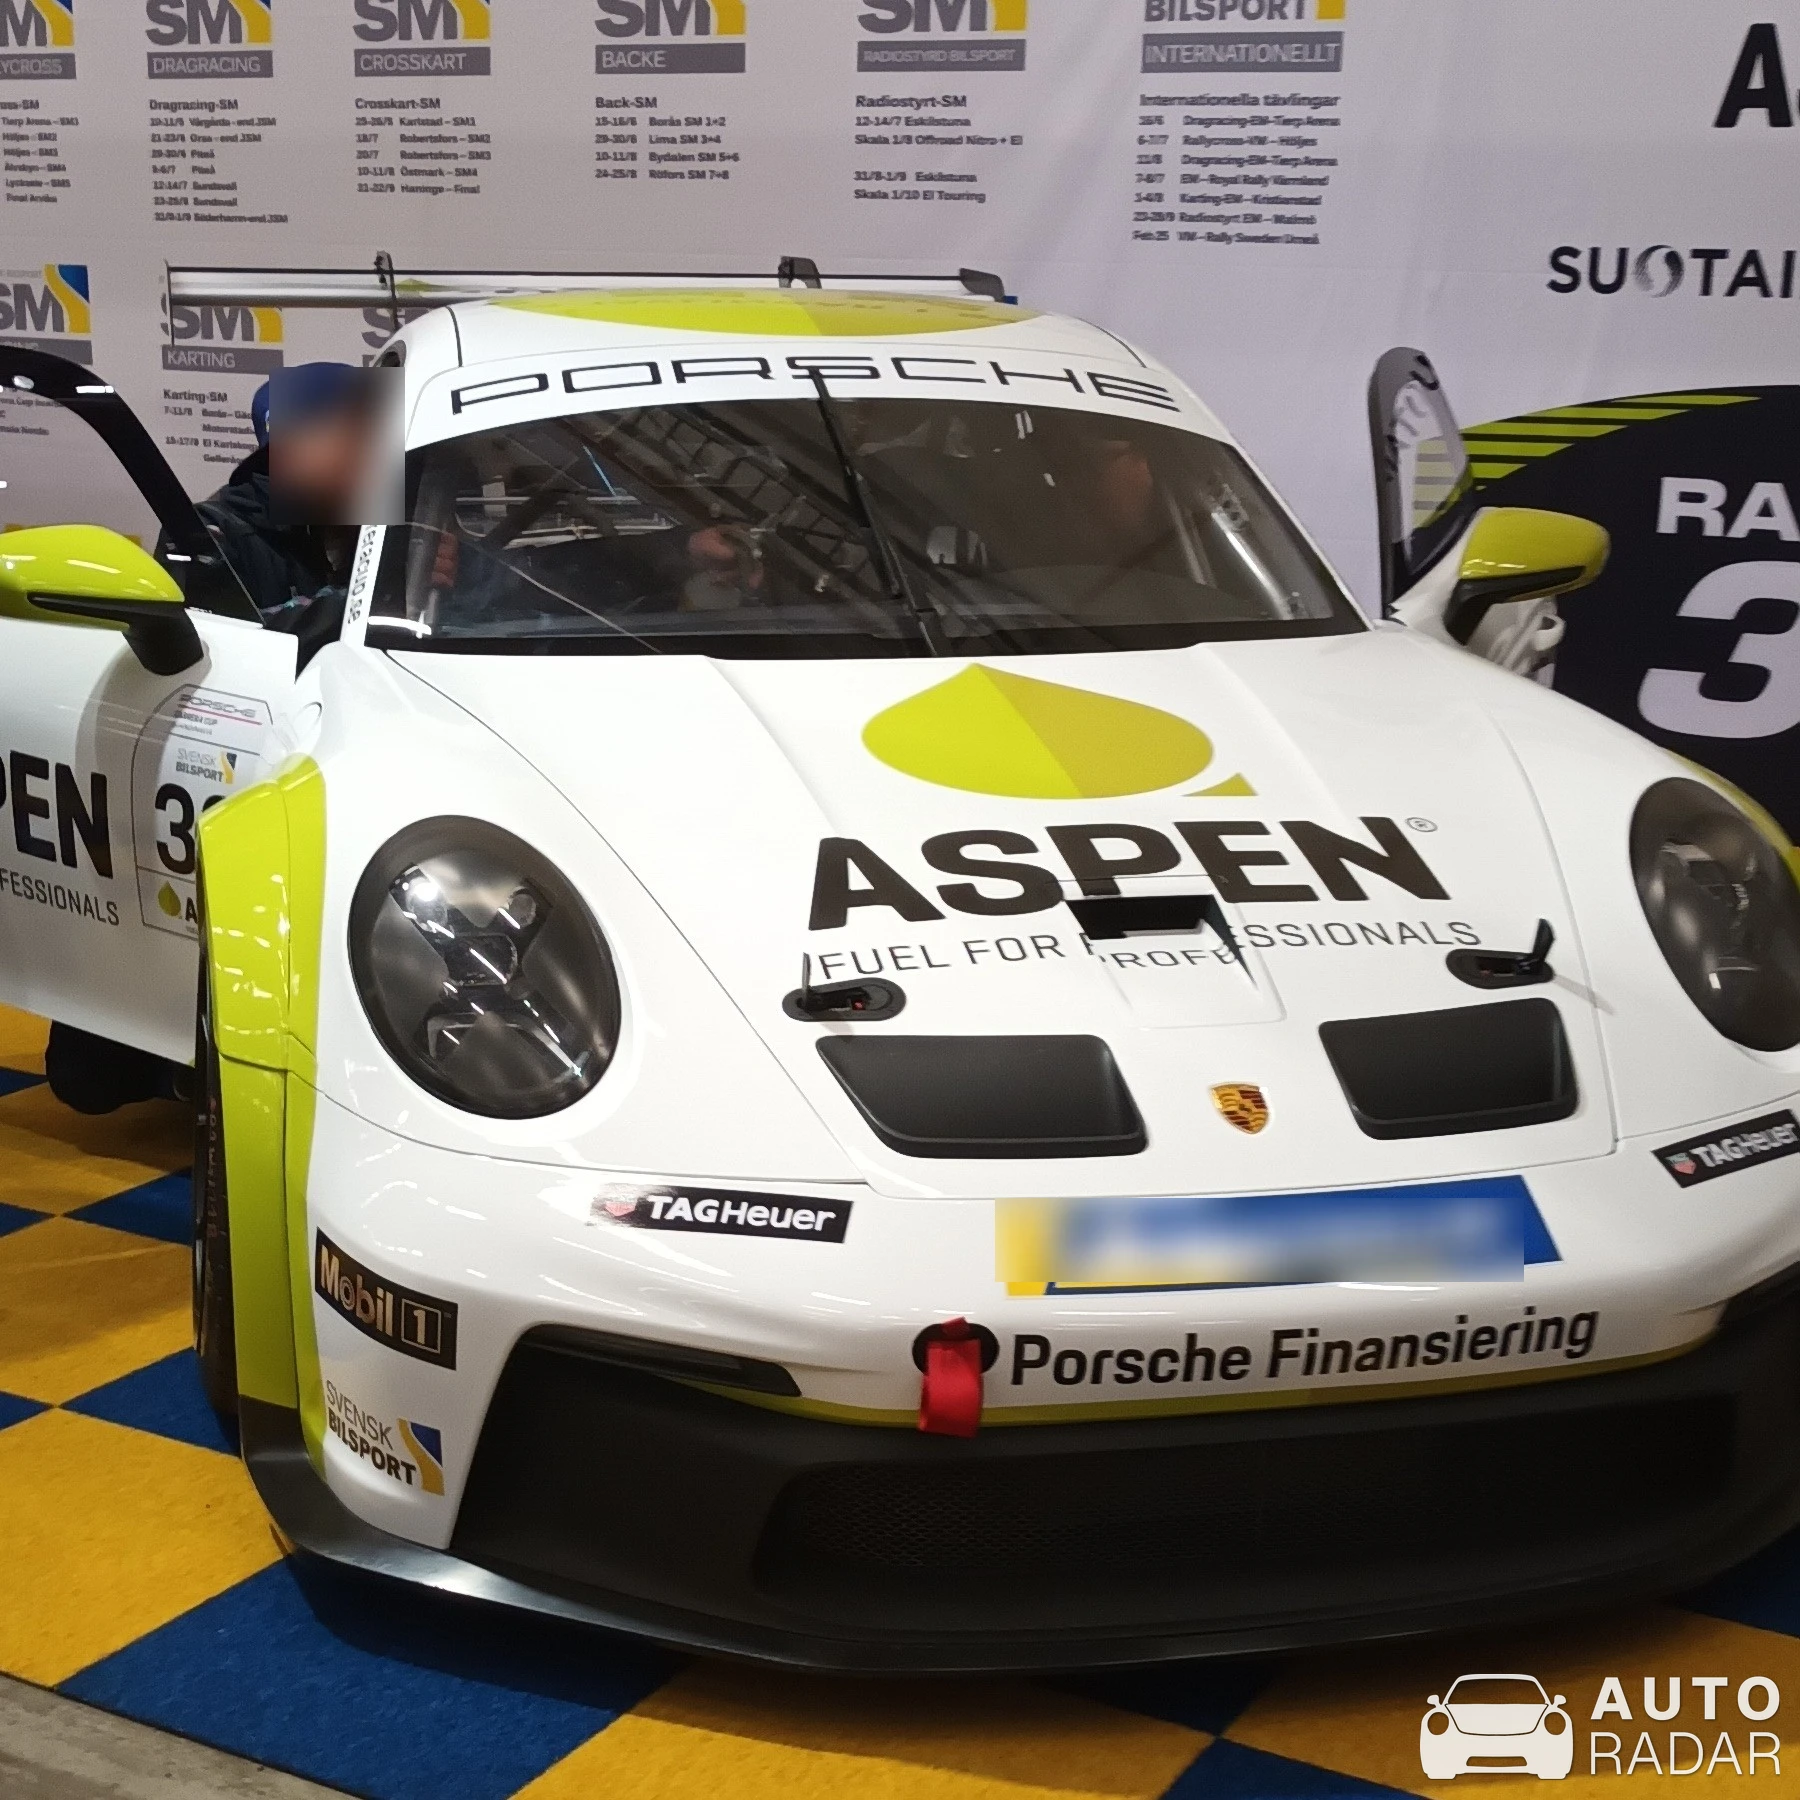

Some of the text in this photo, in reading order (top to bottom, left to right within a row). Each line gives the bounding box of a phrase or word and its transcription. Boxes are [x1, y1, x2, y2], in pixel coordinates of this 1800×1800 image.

[594, 0, 711, 37] SM
[1144, 0, 1305, 21] BILSPORT
[146, 0, 242, 45] SM
[352, 0, 458, 42] SM
[360, 53, 467, 71] CROSSKART
[602, 51, 666, 68] BACKE
[950, 49, 1016, 62] BILSPORT
[1145, 43, 1340, 63] INTERNATIONELLT
[152, 56, 261, 73] DRAGRACING
[149, 98, 238, 113] Dragracing-SM
[355, 97, 441, 109] Crosskart-SM
[595, 96, 657, 108] Back-SM
[855, 95, 967, 110] Radiostyrt-SM
[1140, 93, 1260, 106] Internationella
[166, 350, 236, 369] KARTING
[451, 356, 1181, 415] PORSCHE
[163, 389, 228, 404] Karting-SM
[175, 761, 224, 783] BILSPORT
[819, 934, 1065, 980] FUEL FOR
[320, 1244, 426, 1345] Mobil 1
[1011, 1306, 1600, 1386] Porsche Finansiering
[326, 1379, 394, 1450] SVENSK
[328, 1407, 416, 1486] BILSPORT
